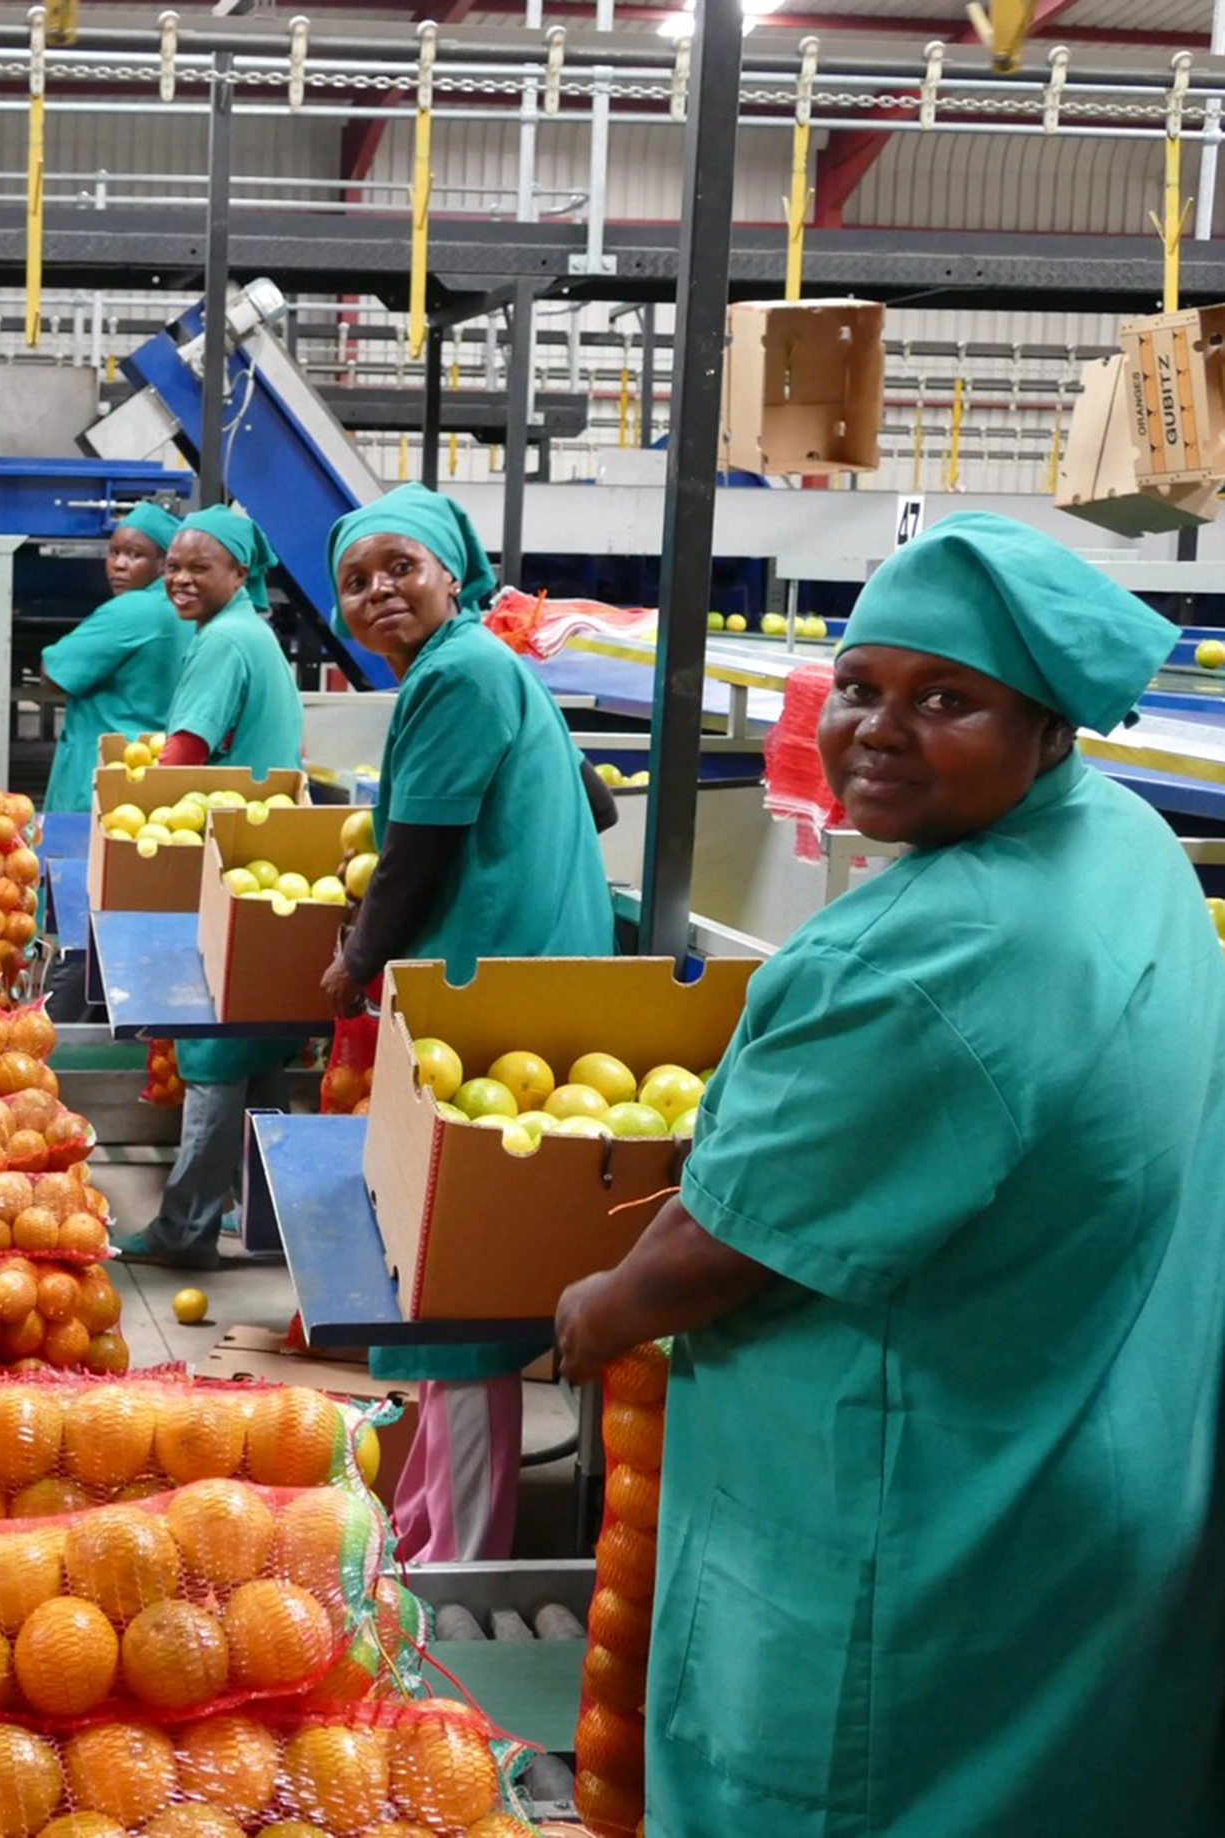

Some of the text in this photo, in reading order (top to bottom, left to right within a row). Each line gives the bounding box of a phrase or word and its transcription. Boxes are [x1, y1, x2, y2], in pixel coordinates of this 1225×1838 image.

[1132, 371, 1147, 436] ORANGES
[1158, 354, 1179, 445] GUBITZ
[897, 501, 921, 545] 47
